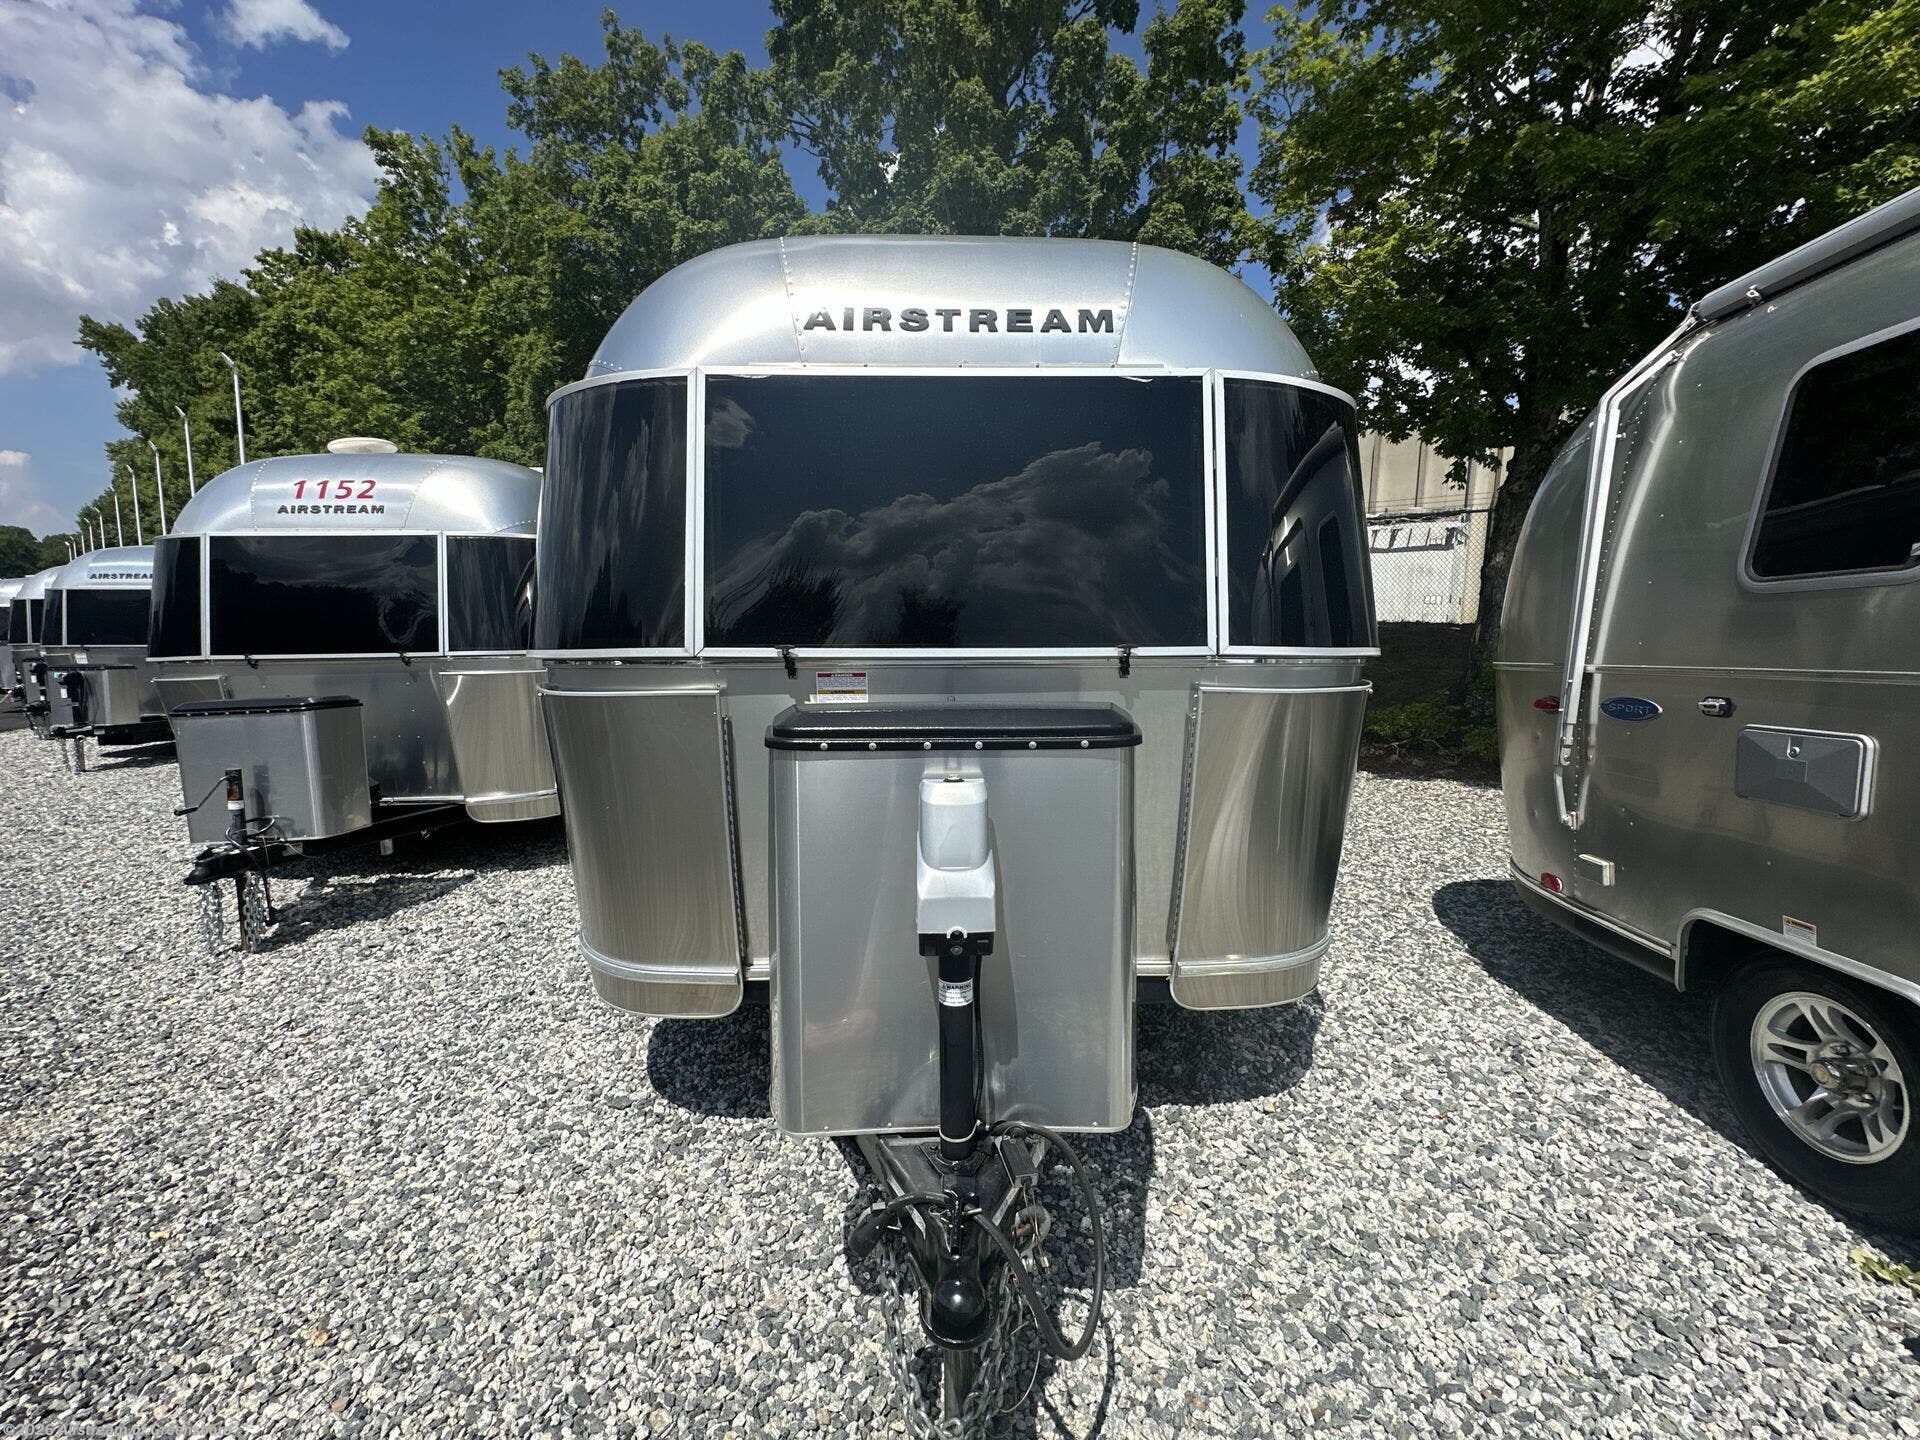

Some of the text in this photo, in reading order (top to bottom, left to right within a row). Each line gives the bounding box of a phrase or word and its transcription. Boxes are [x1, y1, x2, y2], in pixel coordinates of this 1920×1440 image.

[803, 307, 1114, 333] AIRSTREAM
[293, 479, 377, 499] 1152
[277, 504, 385, 514] AIRSTREAM
[1608, 703, 1652, 715] SPORT
